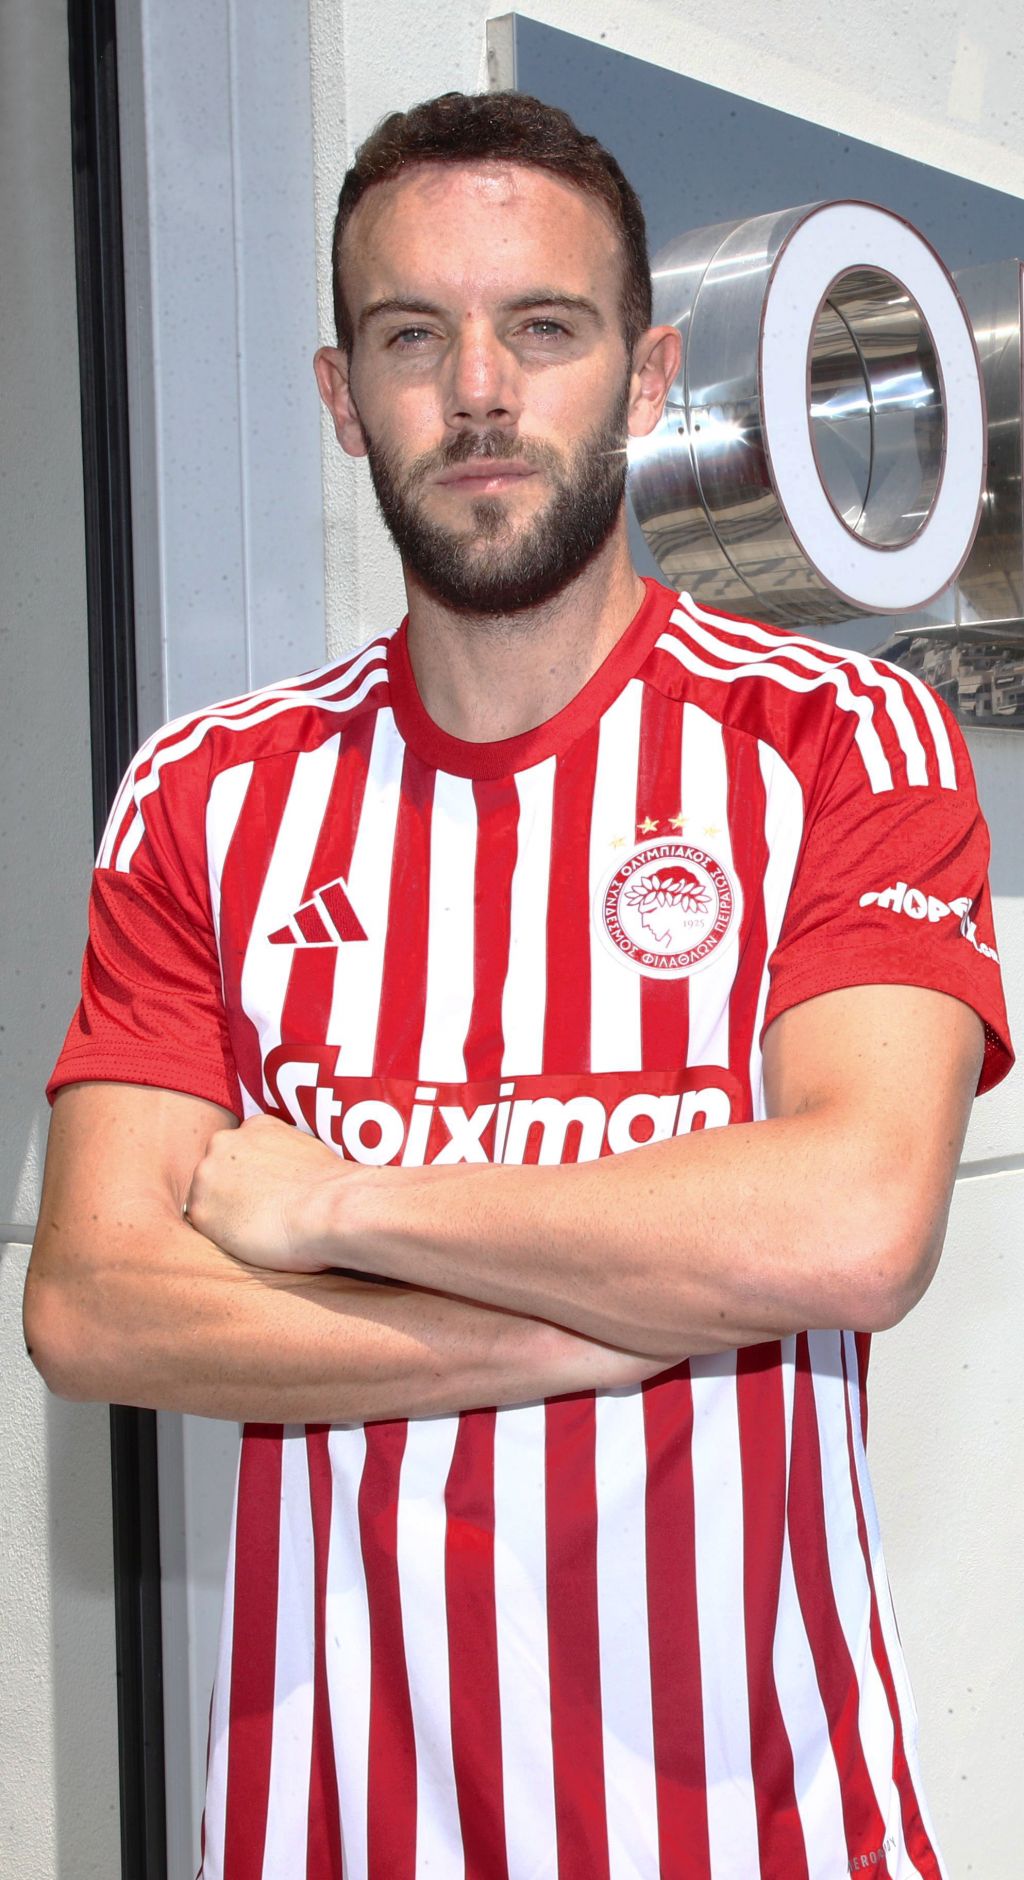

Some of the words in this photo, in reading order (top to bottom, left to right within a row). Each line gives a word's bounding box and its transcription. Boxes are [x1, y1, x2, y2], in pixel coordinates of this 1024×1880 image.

[621, 845, 712, 877] ΟΛΥΜΠΙΑΚΟΣ
[605, 880, 638, 958] ΣΥΝΔΕΣΜΟΣ
[641, 936, 718, 969] ΦΙΛΑΘΛΩΝ
[711, 867, 732, 932] ΠΕΙΡΑΙΩΣ
[682, 918, 705, 929] 1925
[276, 1061, 731, 1166] Stoiximan
